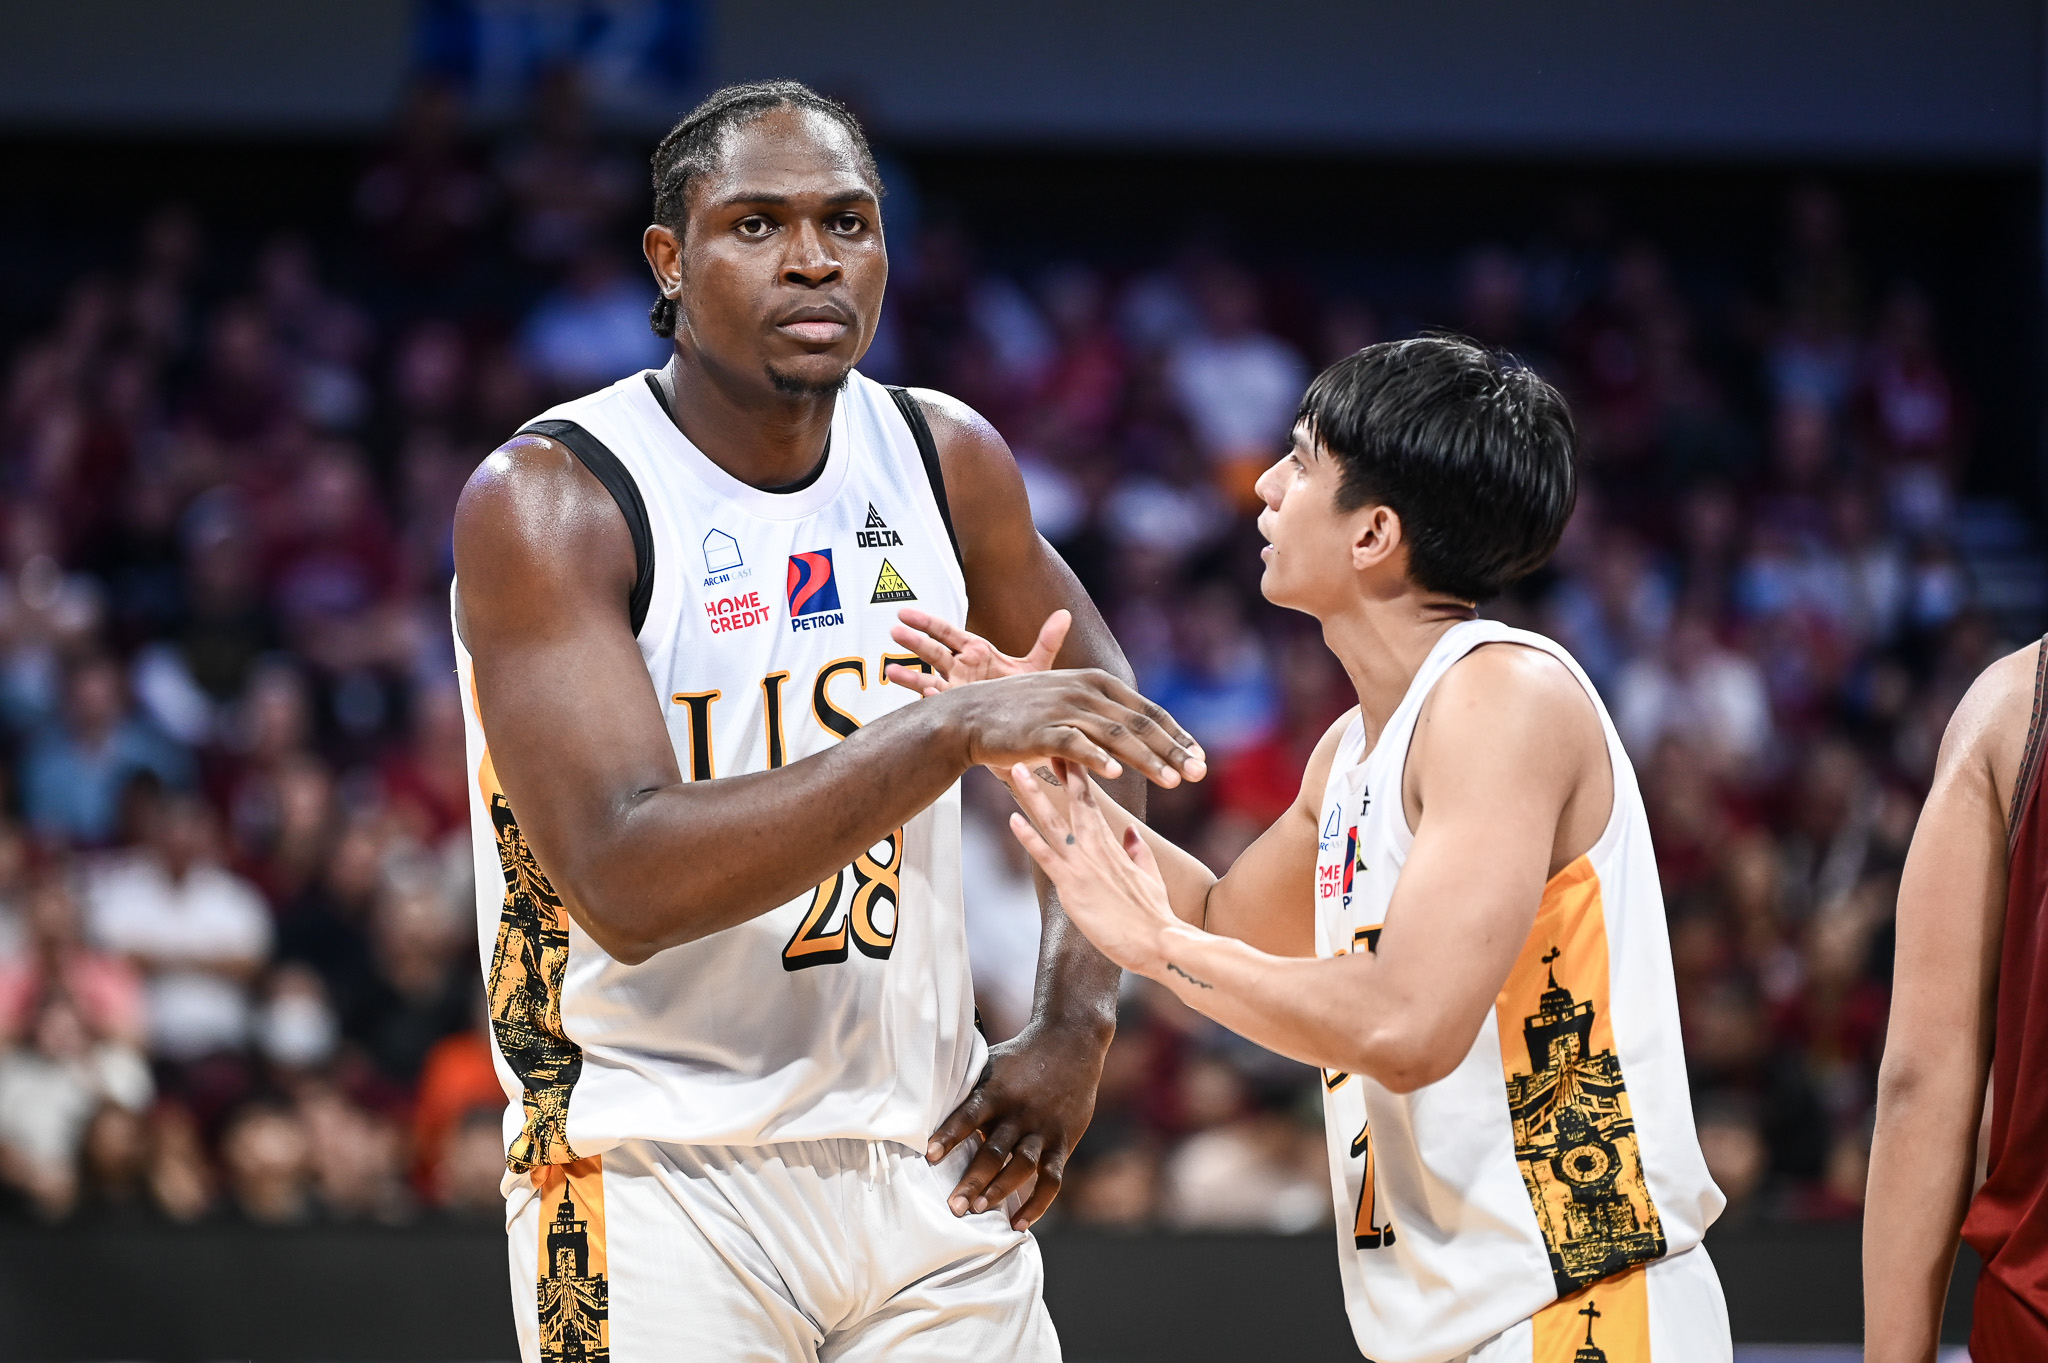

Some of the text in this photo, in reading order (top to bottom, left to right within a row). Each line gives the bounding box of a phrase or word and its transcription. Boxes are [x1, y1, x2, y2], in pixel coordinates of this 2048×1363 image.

[856, 530, 904, 548] DELTA
[703, 568, 753, 587] ARCHI CAST
[879, 583, 887, 591] M
[896, 582, 904, 590] M
[704, 591, 761, 617] HOME
[710, 606, 770, 634] CREDIT
[791, 613, 844, 632] PETRON
[1319, 864, 1341, 881] ME
[782, 826, 903, 972] 28
[1350, 1118, 1397, 1250] 1
